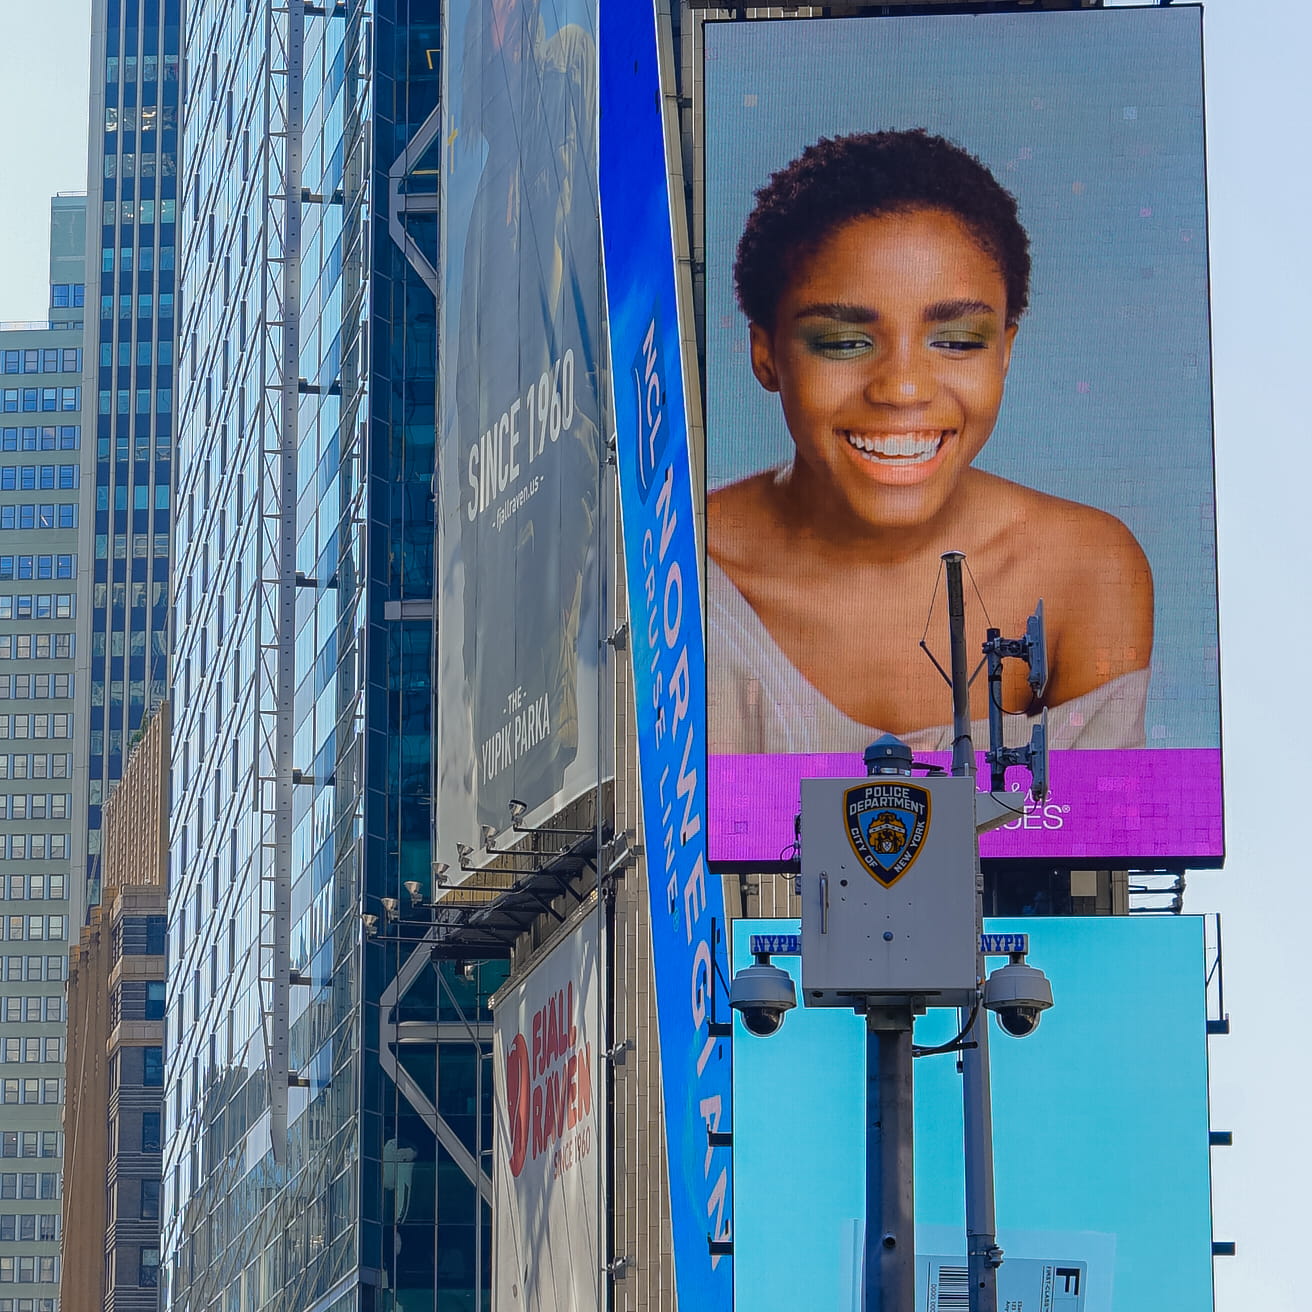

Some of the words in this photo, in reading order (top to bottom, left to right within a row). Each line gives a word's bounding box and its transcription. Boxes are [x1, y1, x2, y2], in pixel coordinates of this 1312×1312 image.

[642, 317, 666, 469] NCL
[467, 397, 522, 522] SINCE
[526, 348, 575, 464] 1960
[642, 528, 667, 750] CRUISE
[507, 685, 522, 716] THE
[481, 721, 512, 786] YUPIK
[514, 692, 551, 761] PARKA
[849, 796, 926, 816] DEPARTMENT
[865, 785, 910, 799] POLICE
[850, 827, 867, 852] CITY
[864, 855, 878, 869] OF
[893, 851, 913, 873] NEW
[909, 821, 926, 848] YORK
[654, 472, 731, 1271] NORWEGIAN
[753, 934, 799, 953] NYPD
[979, 934, 1025, 952] NYPD
[554, 1140, 573, 1181] SINCE
[574, 1125, 591, 1164] 1960
[1056, 1267, 1081, 1296] F
